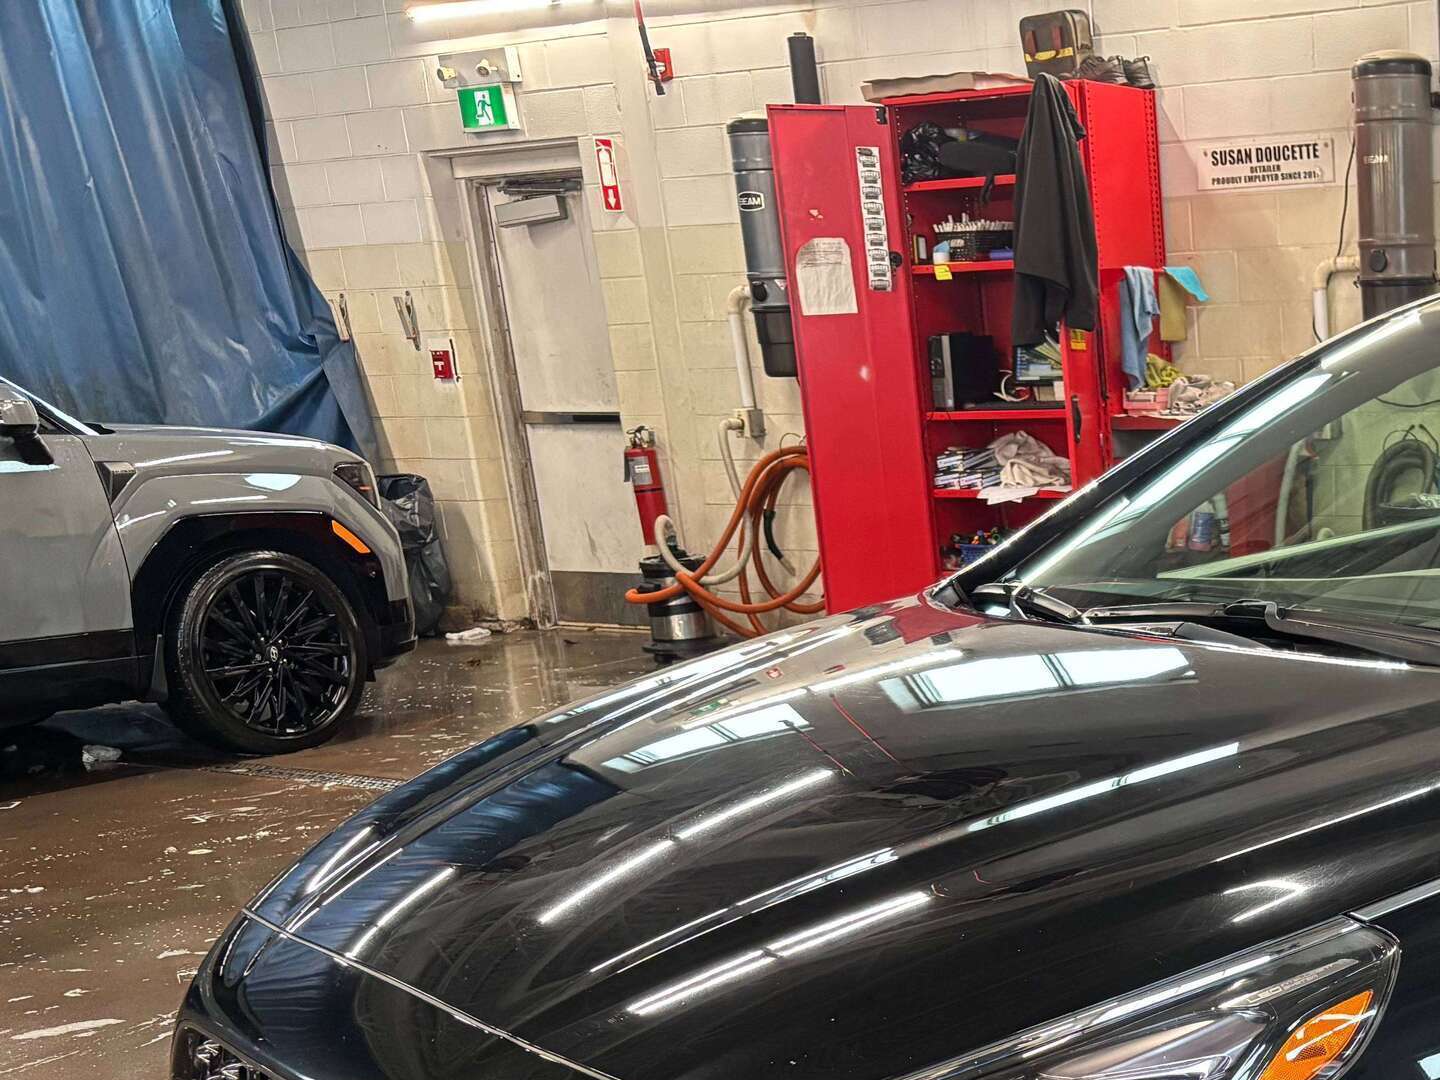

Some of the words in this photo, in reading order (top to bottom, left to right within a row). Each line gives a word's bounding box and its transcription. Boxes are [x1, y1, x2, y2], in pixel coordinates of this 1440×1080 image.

[1211, 148, 1253, 166] SUSAN
[1255, 143, 1319, 162] DOUCETTE
[1249, 164, 1281, 174] DETAILER
[1211, 175, 1242, 186] PROUDLY
[1243, 173, 1280, 184] EMPLOYED
[1280, 171, 1302, 182] SINCE
[1303, 170, 1320, 180] 201
